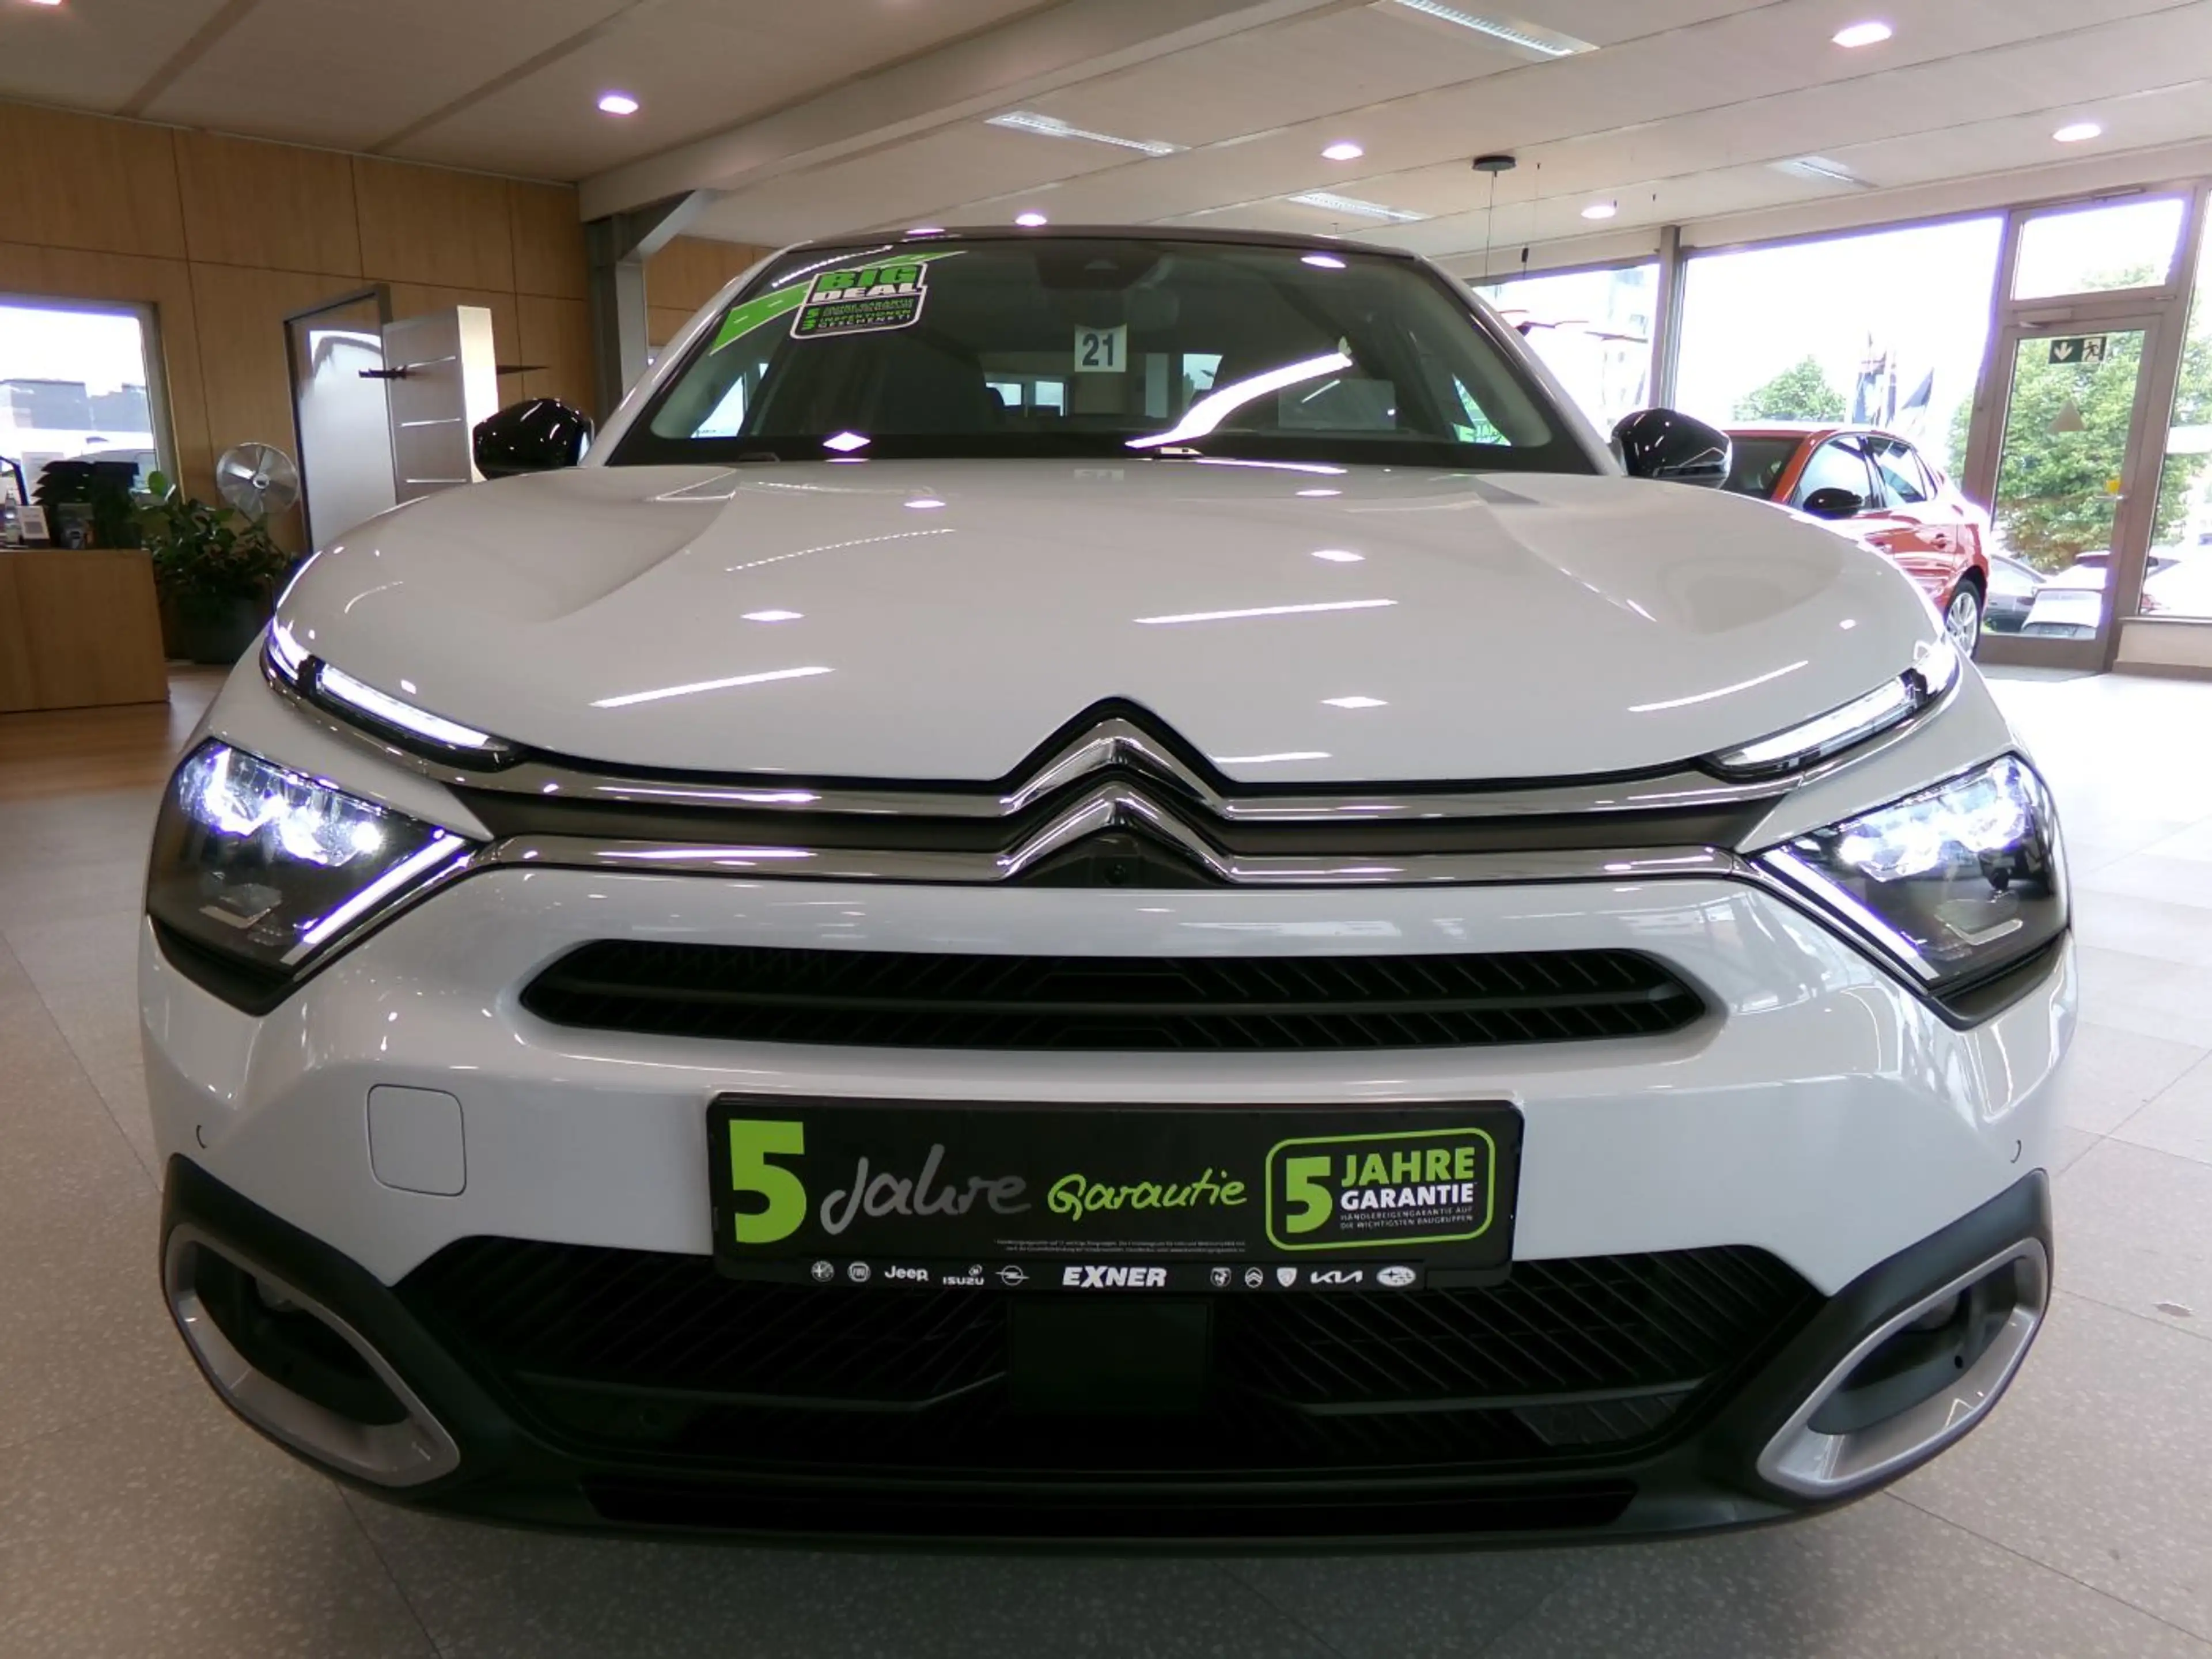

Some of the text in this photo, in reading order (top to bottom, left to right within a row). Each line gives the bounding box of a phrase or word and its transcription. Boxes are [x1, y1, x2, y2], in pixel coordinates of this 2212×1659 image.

[817, 266, 917, 290] BIG
[812, 283, 916, 302] DEAL
[1082, 333, 1113, 367] 21
[1341, 1147, 1475, 1187] JAHRE
[729, 1119, 806, 1244] 5
[820, 1143, 1031, 1235] Jahre
[1286, 1156, 1332, 1233] 5
[1340, 1184, 1474, 1211] GARANTIE
[1357, 1219, 1415, 1229] WICHTIGSTEN
[1417, 1215, 1473, 1225] BAUGRUPPEN
[884, 1266, 929, 1282] Jeep
[942, 1277, 985, 1286] ISUZU
[1062, 1266, 1167, 1288] EXNER
